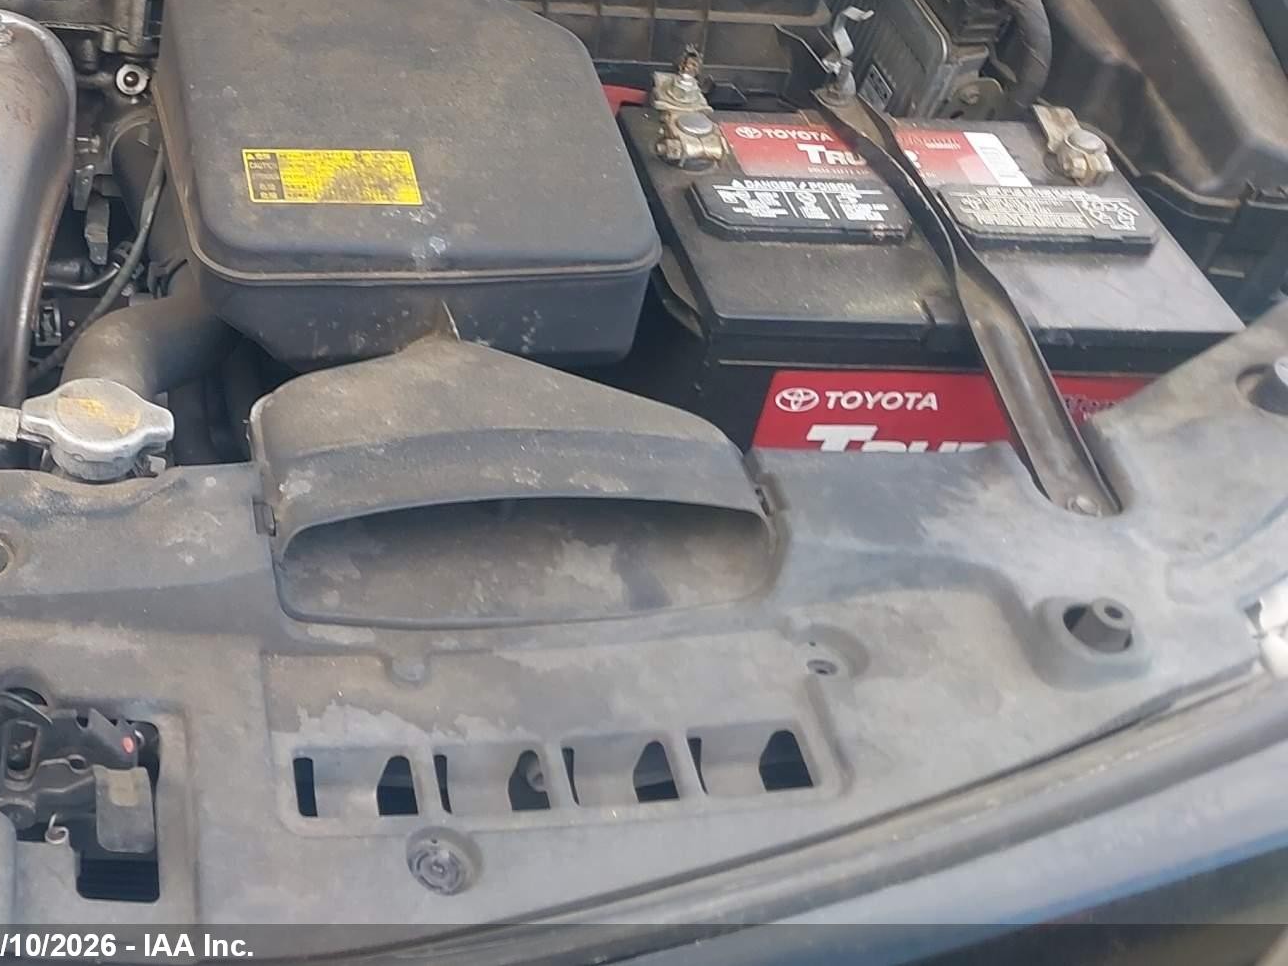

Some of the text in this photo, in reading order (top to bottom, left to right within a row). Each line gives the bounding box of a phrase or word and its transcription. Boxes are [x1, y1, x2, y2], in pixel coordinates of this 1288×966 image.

[760, 127, 836, 143] TOYOTA
[744, 179, 797, 192] DANGER
[807, 181, 856, 194] POISON
[824, 390, 939, 412] TOYOTA
